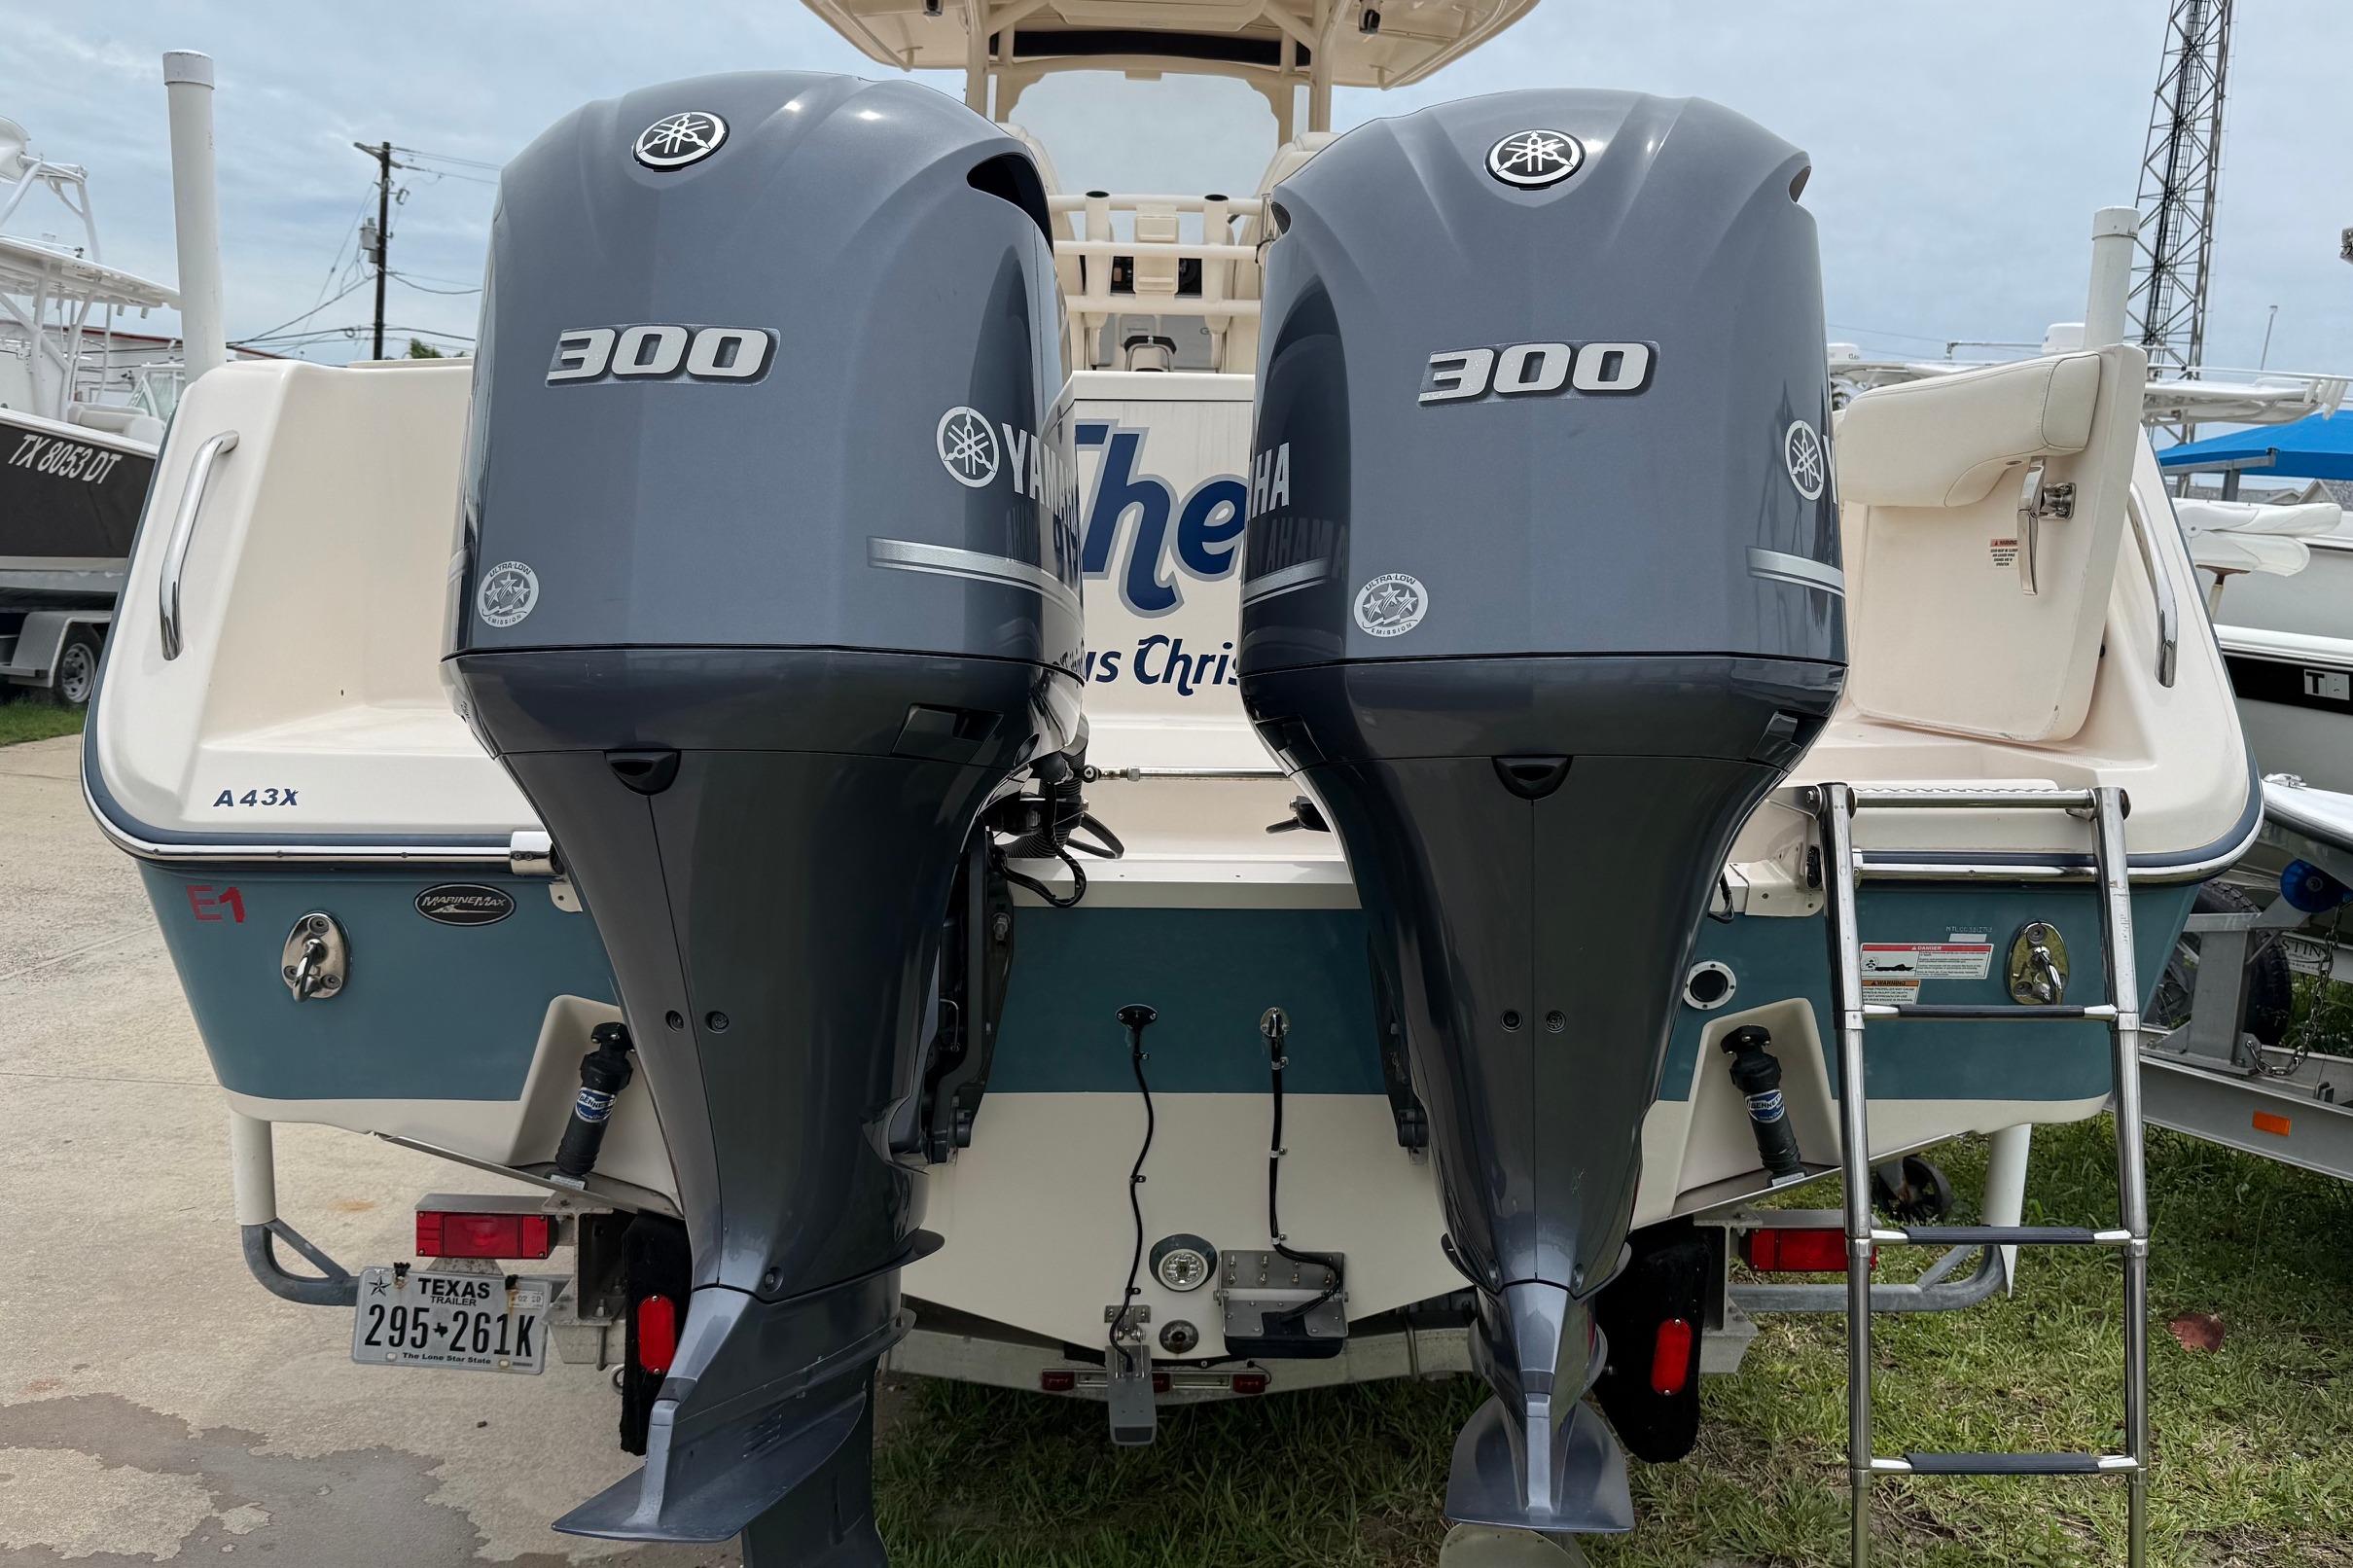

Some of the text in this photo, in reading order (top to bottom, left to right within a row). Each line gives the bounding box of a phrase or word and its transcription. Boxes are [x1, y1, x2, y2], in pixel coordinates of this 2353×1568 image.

[547, 325, 769, 381] 300
[1417, 342, 1651, 403] 300
[8, 434, 124, 484] TX 8053 DT
[487, 614, 521, 625] EMISSION
[1371, 623, 1412, 635] EMISSION
[186, 885, 246, 923] E1
[418, 1277, 490, 1300] TEXAS
[431, 1296, 477, 1307] TRAILER
[365, 1304, 535, 1357] 295 261K
